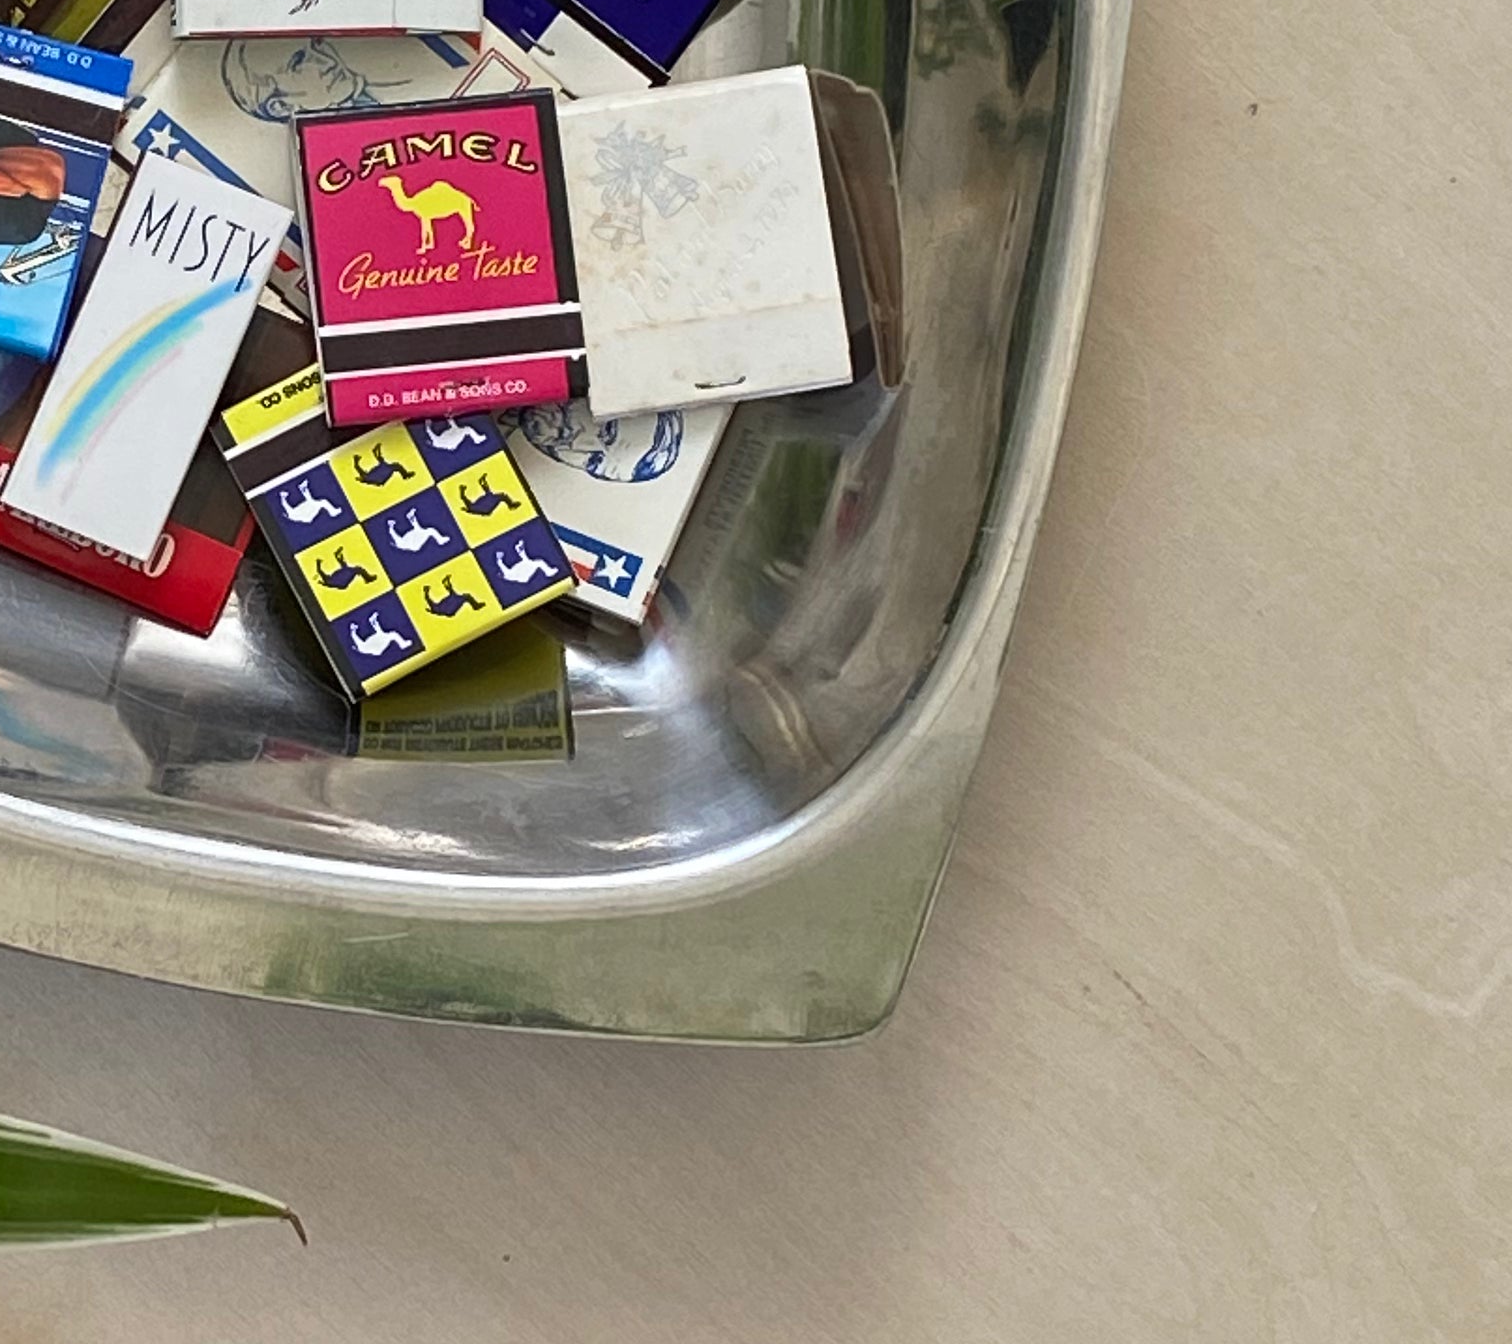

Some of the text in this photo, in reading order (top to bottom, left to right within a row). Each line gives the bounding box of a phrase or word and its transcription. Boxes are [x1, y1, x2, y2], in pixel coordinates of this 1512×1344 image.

[5, 34, 20, 48] &
[19, 38, 61, 60] BEAN
[317, 131, 538, 193] CAMEL
[129, 190, 271, 293] MISTY
[338, 240, 539, 301] Genuine Taste
[368, 391, 399, 409] D.D.
[401, 387, 440, 405] BEAN
[444, 387, 457, 402] &
[457, 381, 502, 400] SONS
